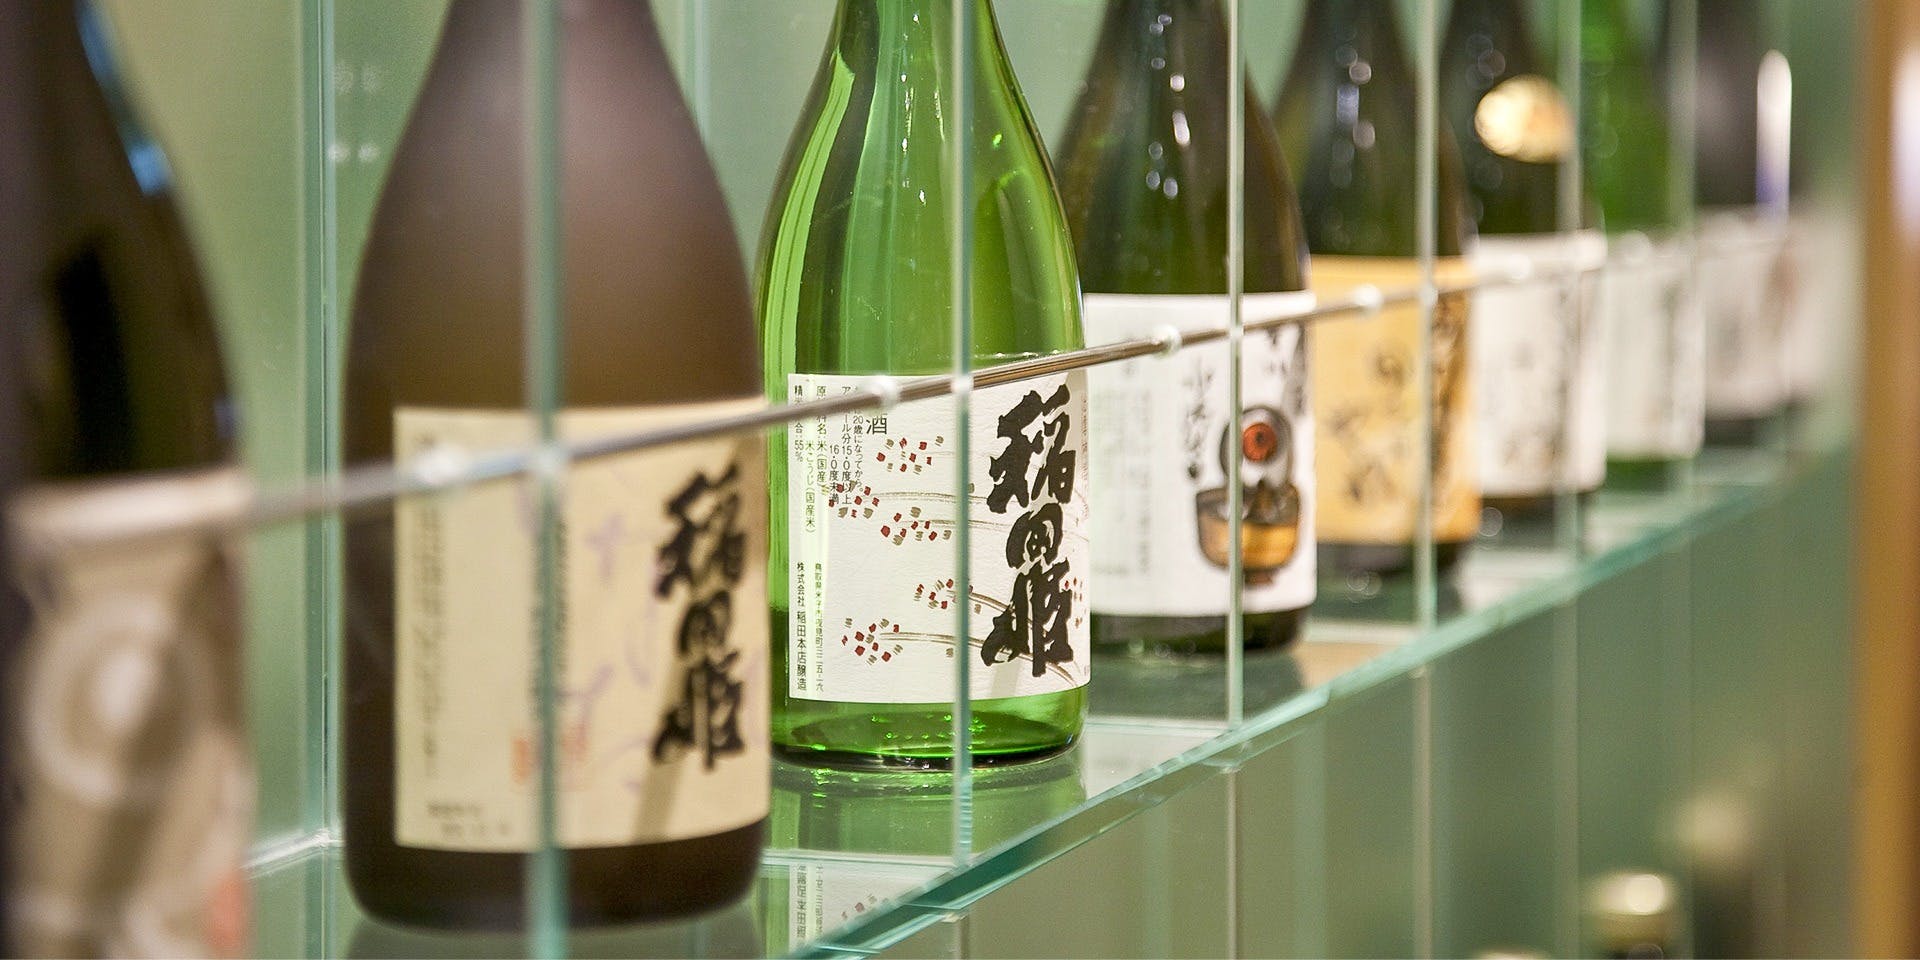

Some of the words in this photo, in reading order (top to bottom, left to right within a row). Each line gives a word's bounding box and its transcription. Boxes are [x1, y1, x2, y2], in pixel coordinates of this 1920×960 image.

[652, 461, 748, 772] 稲田姫
[981, 384, 1076, 677] 稲田姫
